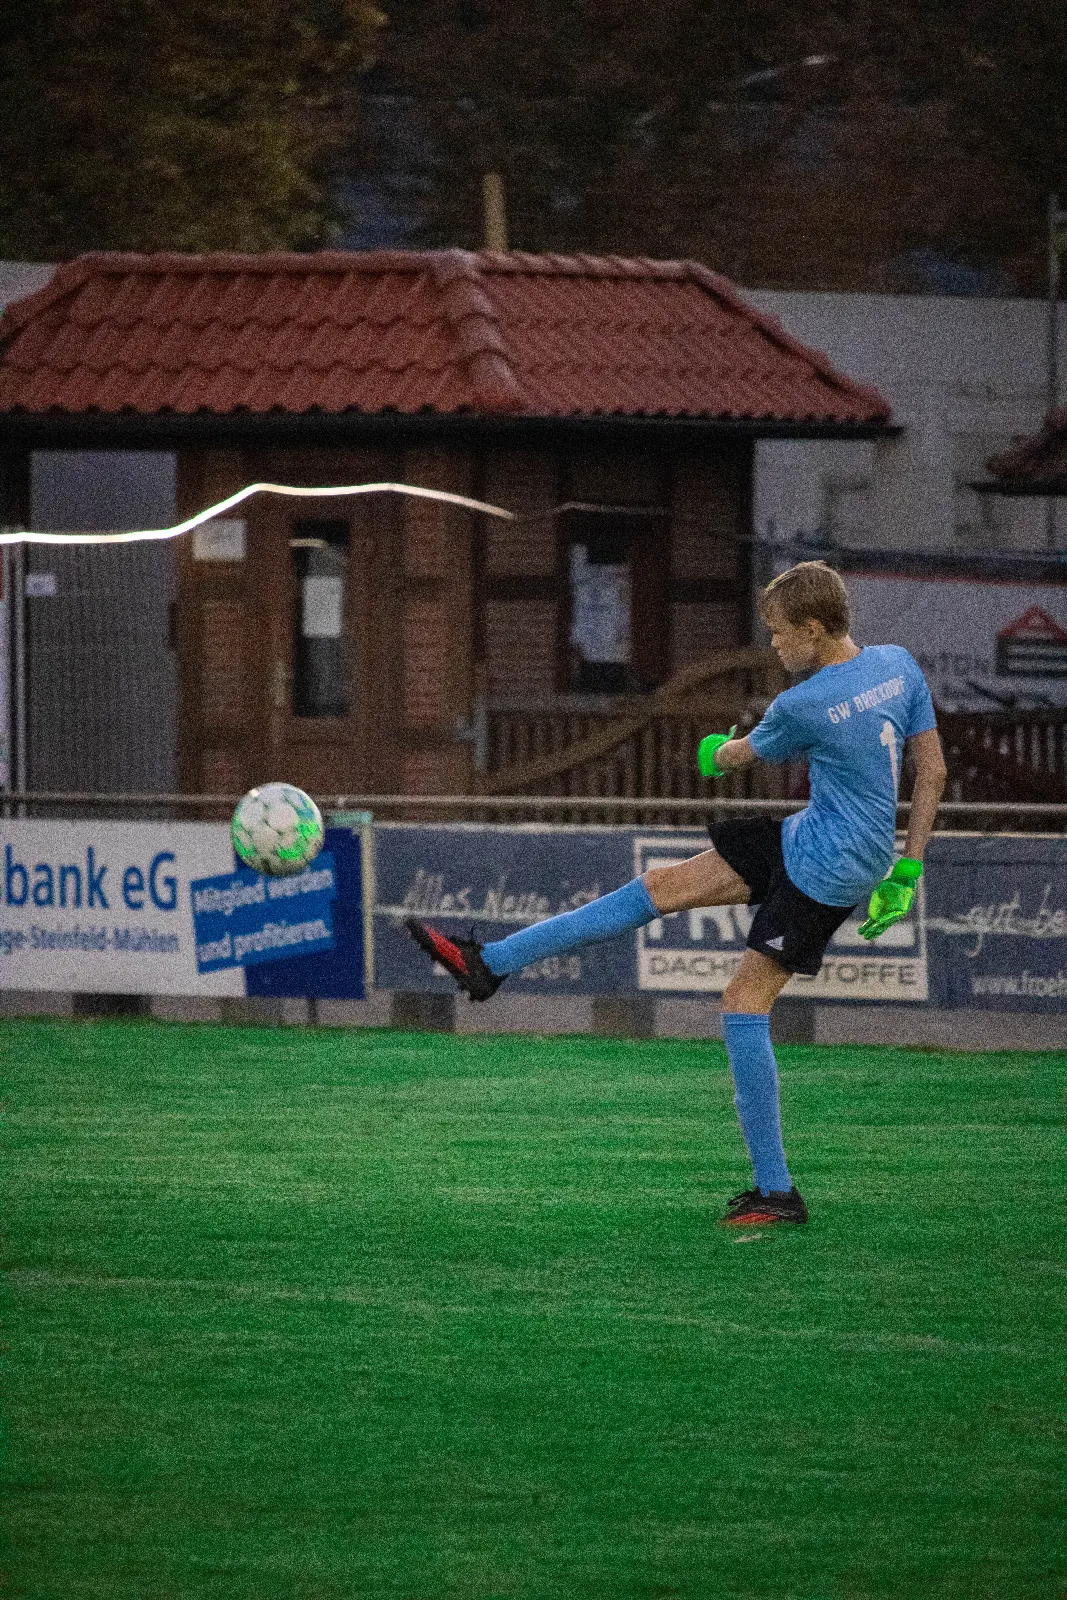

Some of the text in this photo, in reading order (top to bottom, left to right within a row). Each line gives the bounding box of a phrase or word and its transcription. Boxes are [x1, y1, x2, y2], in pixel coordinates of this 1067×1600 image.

[828, 701, 852, 725] GW
[880, 720, 898, 806] 1
[122, 850, 179, 912] eG
[197, 931, 232, 962] und
[649, 956, 917, 986] DACHTOFFE
